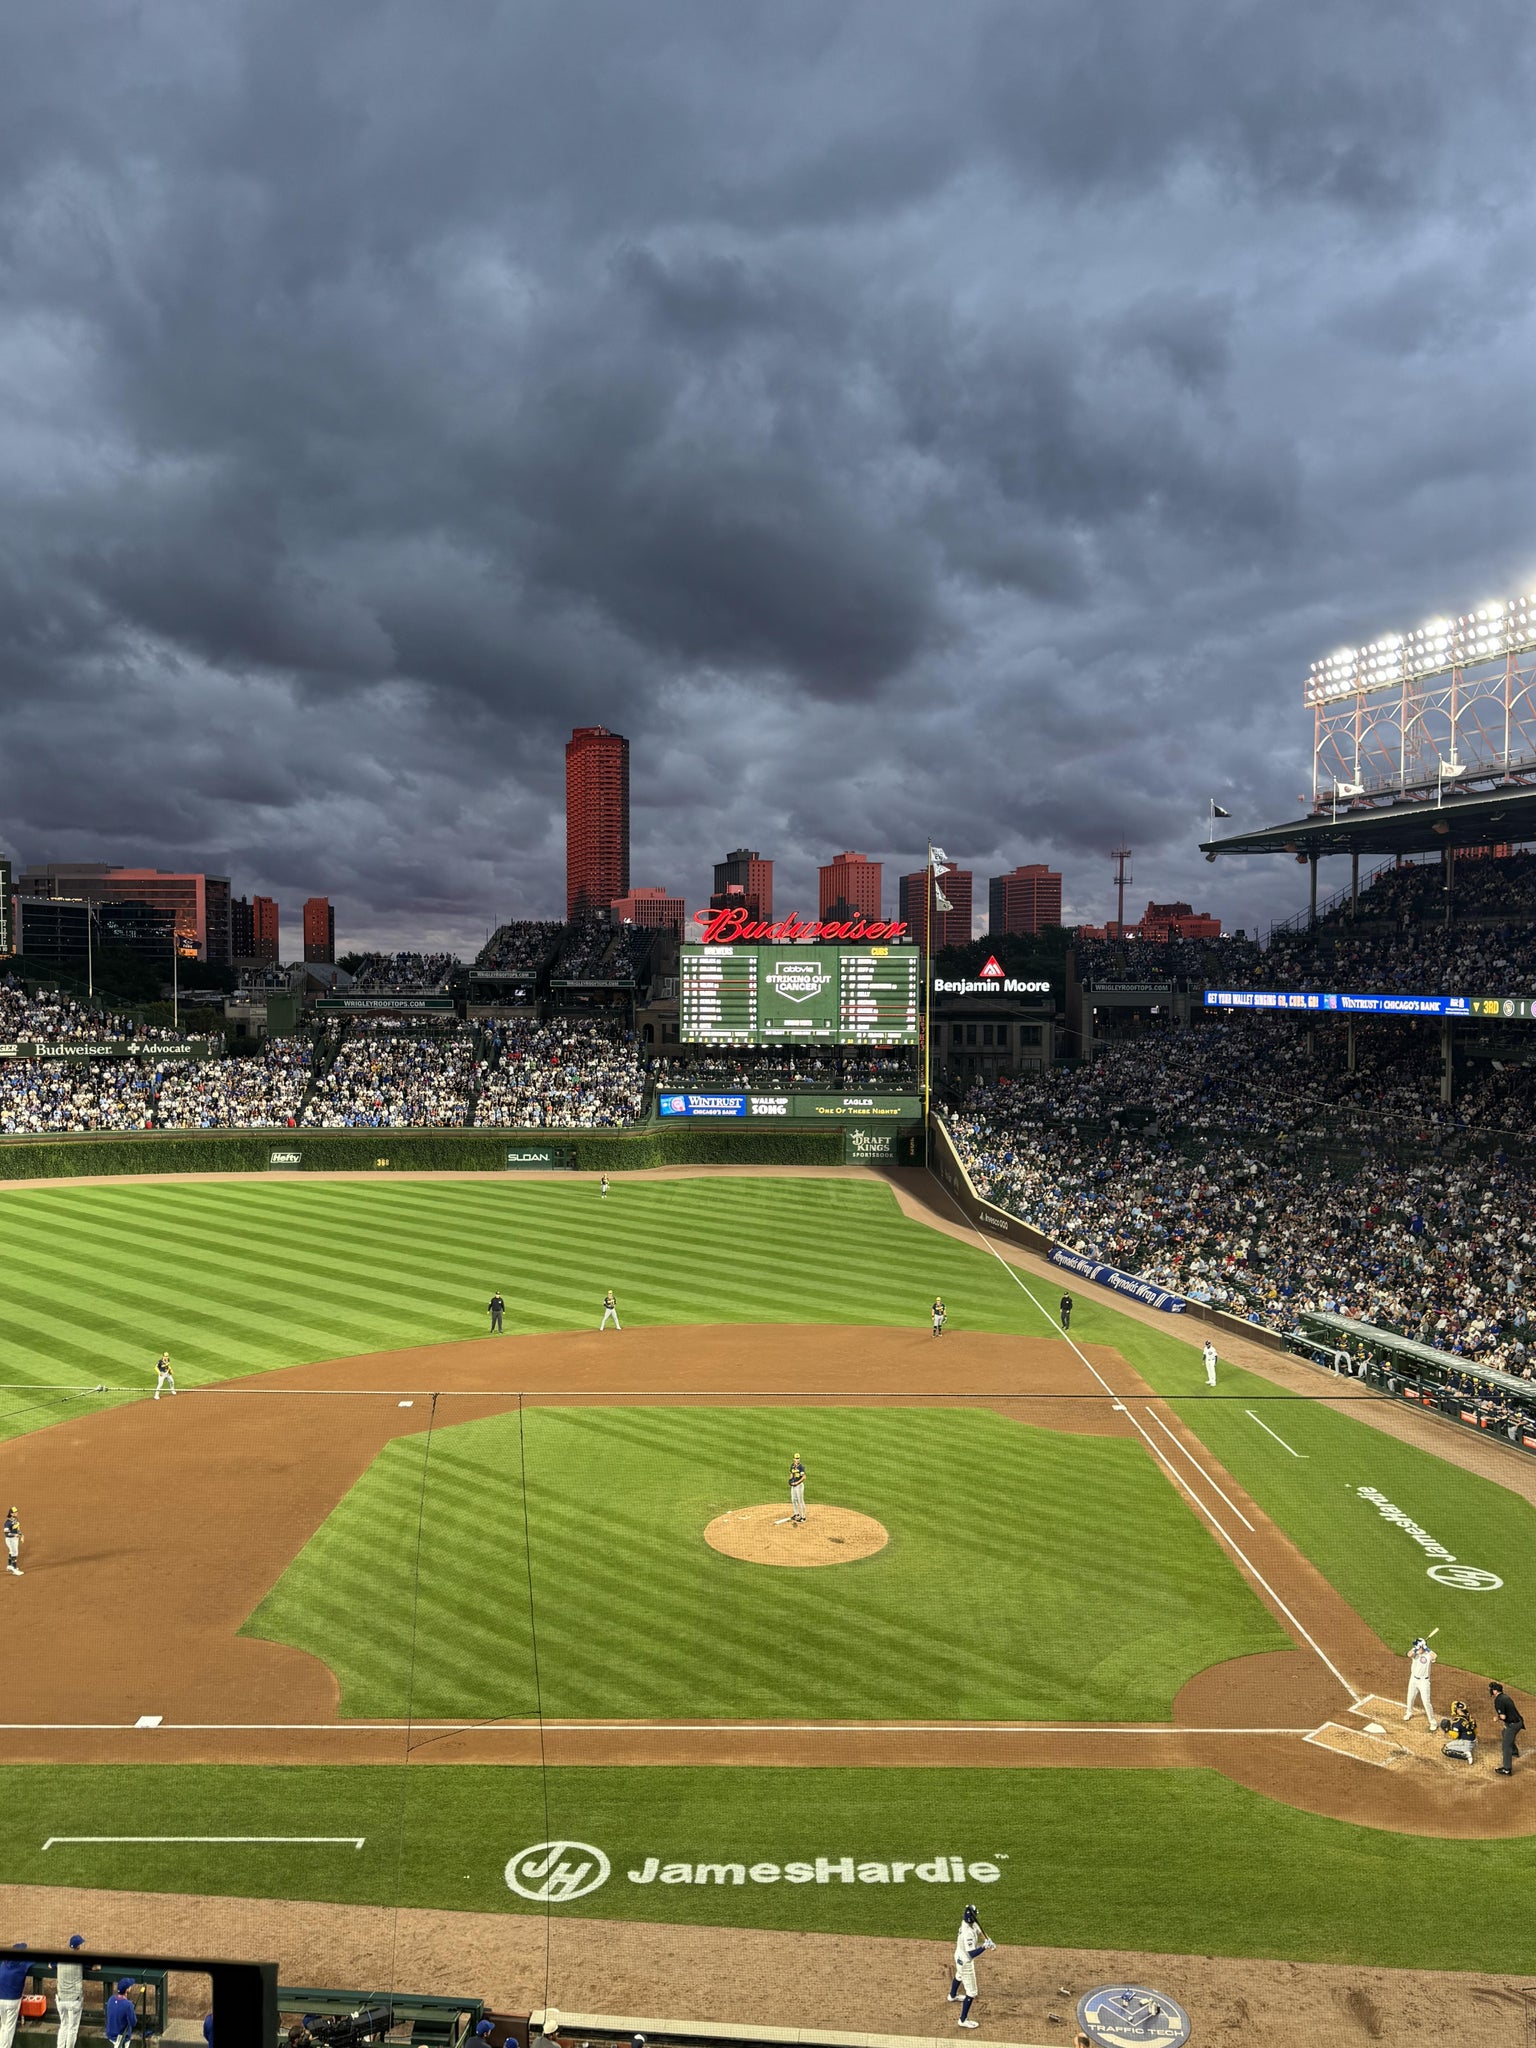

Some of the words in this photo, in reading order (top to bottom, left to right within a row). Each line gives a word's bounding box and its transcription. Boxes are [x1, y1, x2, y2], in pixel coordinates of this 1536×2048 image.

[693, 907, 908, 943] Budweiser
[766, 975, 811, 983] STRIKING
[812, 975, 832, 983] OUT
[934, 979, 1000, 995] Benjamin
[1004, 979, 1050, 992] Moore
[1384, 998, 1420, 1010] CHICAGO'S
[1420, 1001, 1441, 1011] BANK
[1483, 1000, 1499, 1014] 3RD
[1520, 1002, 1525, 1015] 1
[142, 1044, 191, 1053] Advocate
[751, 1097, 788, 1105] WALK-UP
[752, 1105, 787, 1115] SONG
[852, 1135, 891, 1145] DRAFT
[857, 1144, 890, 1152] KINGS
[272, 1153, 300, 1163] Hefty
[508, 1153, 549, 1162] SLOAN
[1053, 1251, 1079, 1268] Reynolds
[1076, 1259, 1093, 1276] Wrap
[1107, 1273, 1139, 1293] Reynolds
[1136, 1285, 1157, 1304] Wrap
[627, 1857, 1001, 1885] JamesHardie
[1087, 2024, 1145, 2034] TRAFFIC
[1147, 2028, 1185, 2037] TECH
